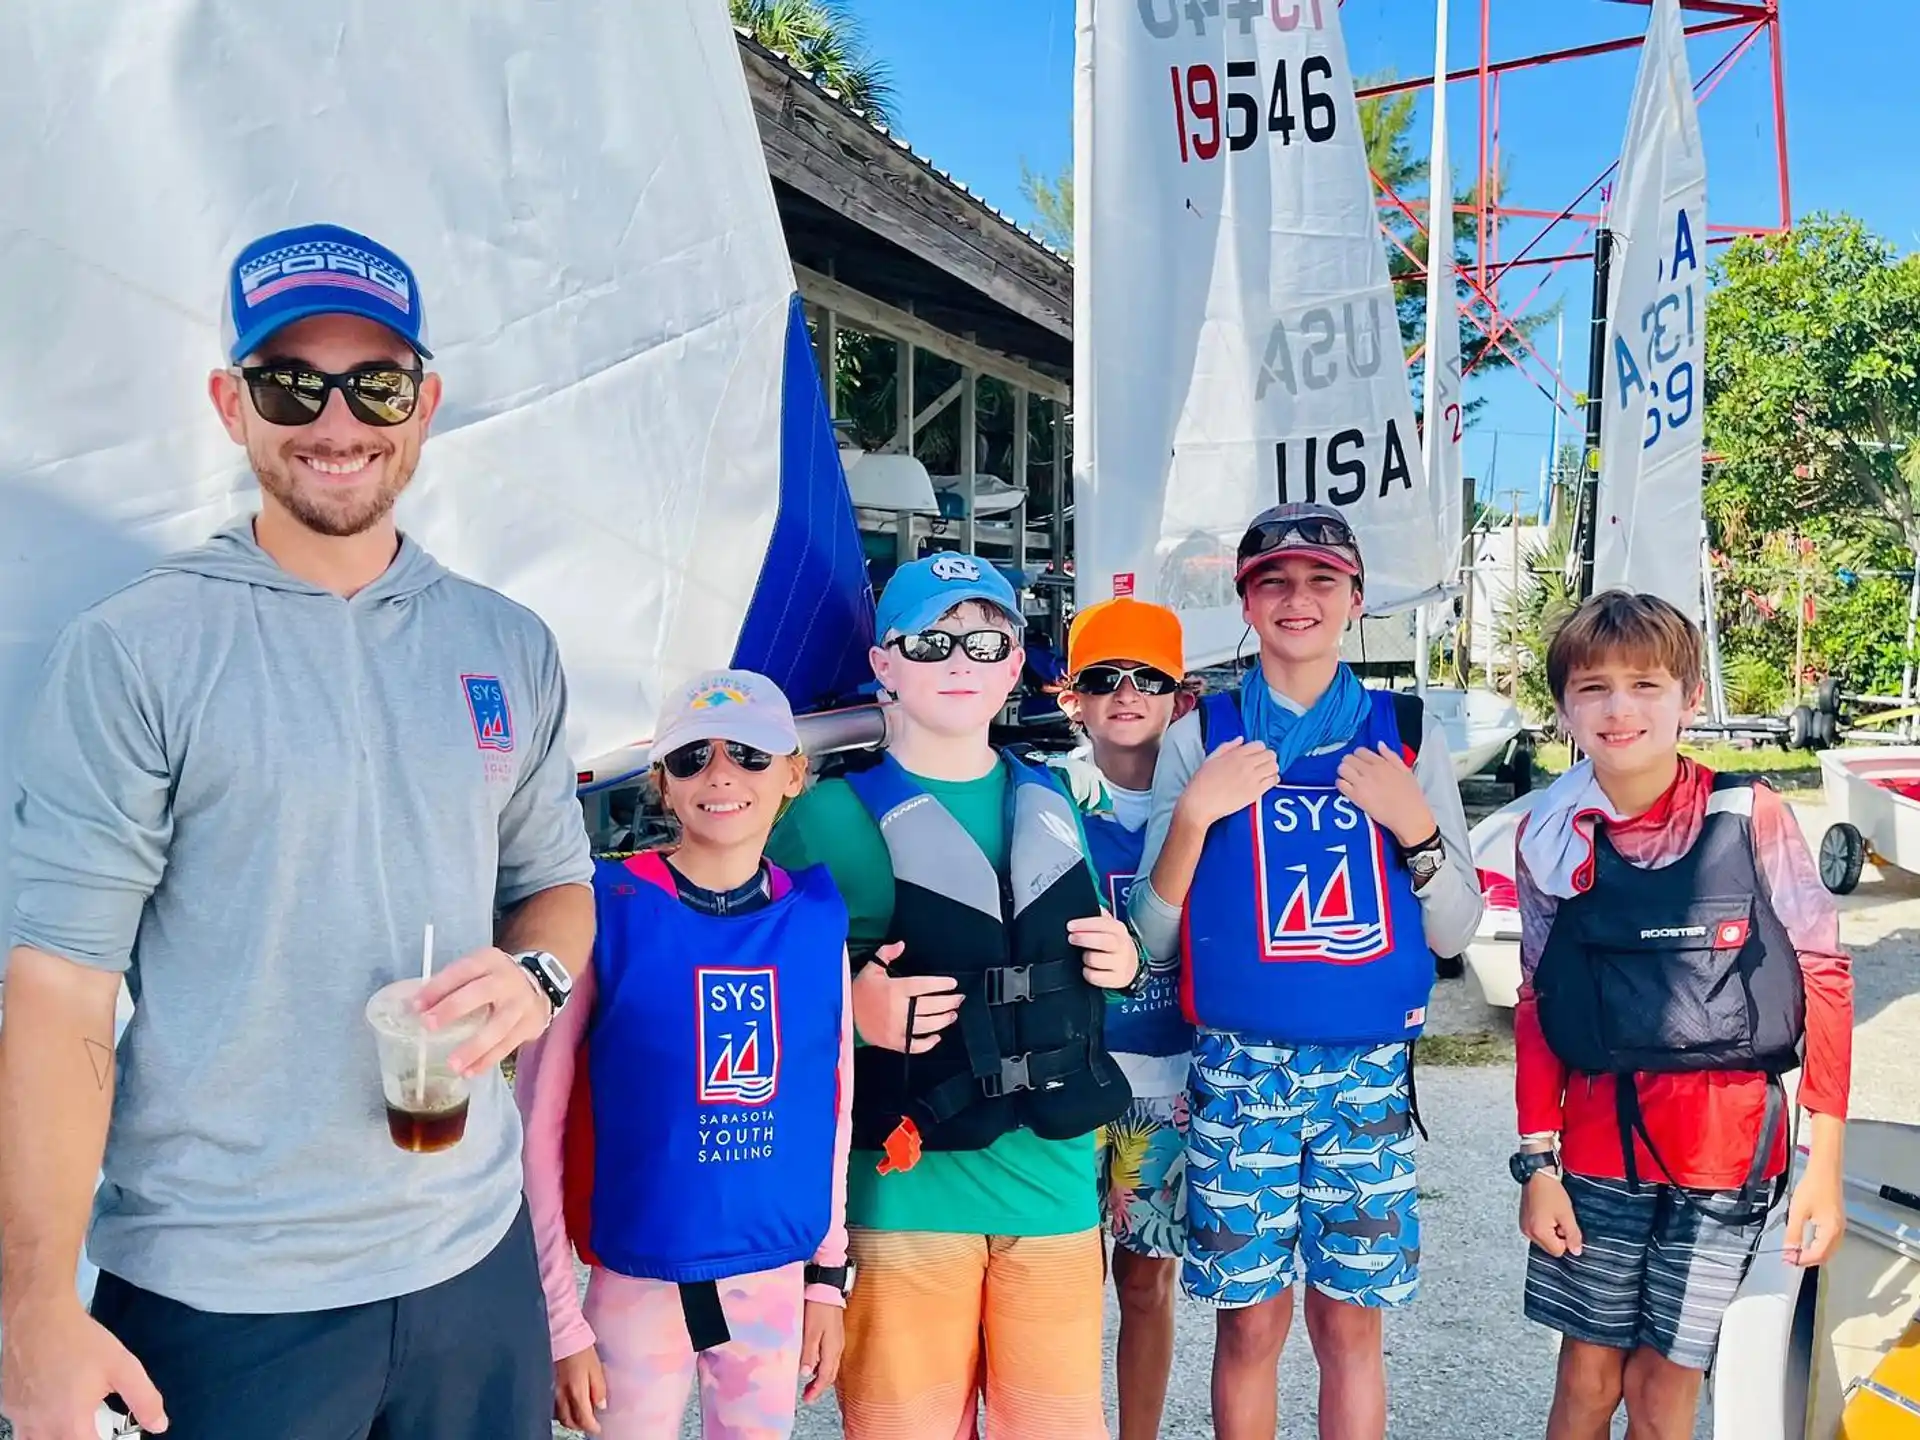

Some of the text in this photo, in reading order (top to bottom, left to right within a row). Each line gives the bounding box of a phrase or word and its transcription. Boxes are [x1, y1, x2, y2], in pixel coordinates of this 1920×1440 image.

[1170, 55, 1336, 163] 19546
[1275, 418, 1412, 506] USA
[472, 685, 501, 701] SYS
[1273, 795, 1358, 832] SYS
[1641, 926, 1707, 939] ROOSTER
[710, 982, 766, 1012] SYS
[699, 1110, 775, 1125] SARASOTA
[698, 1126, 774, 1146] YOUTH
[698, 1145, 773, 1163] SAILING
